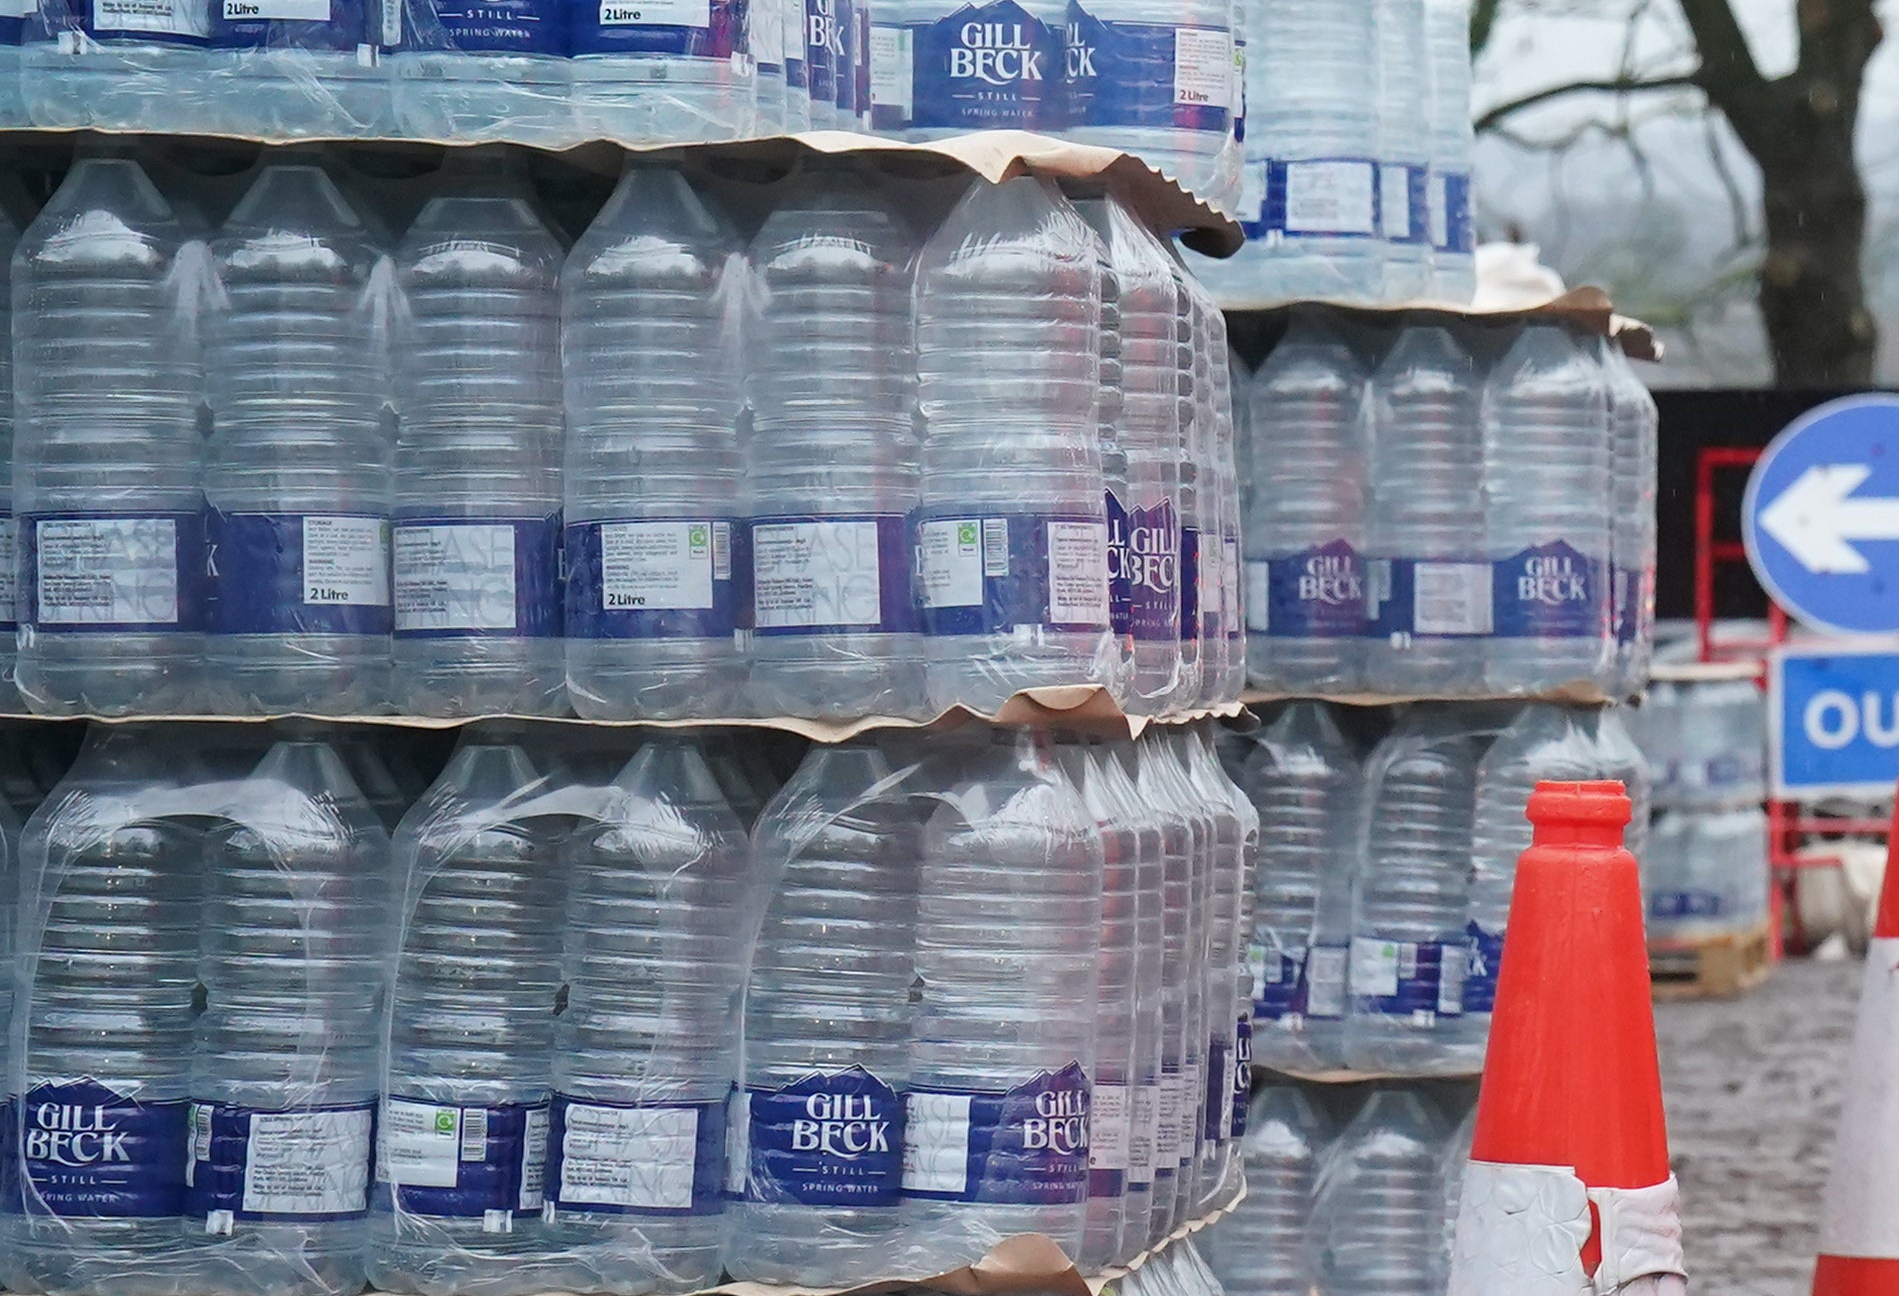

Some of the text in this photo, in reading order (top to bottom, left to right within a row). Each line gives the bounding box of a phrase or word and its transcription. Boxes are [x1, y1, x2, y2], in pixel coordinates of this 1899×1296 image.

[227, 3, 259, 15] 2 Litre
[467, 9, 513, 21] STILL
[605, 8, 641, 20] 2 Litre
[449, 28, 532, 39] SPRING WATER
[961, 22, 1031, 49] GILL
[950, 48, 1043, 85] BECK
[978, 92, 1017, 102] STILL
[1180, 90, 1186, 100] 2
[962, 108, 998, 117] SPRING
[1131, 555, 1174, 594] BEC
[1307, 555, 1352, 577] GILL
[1525, 556, 1573, 578] GILL
[310, 588, 349, 600] 2 Litre
[608, 593, 645, 605] 2 Litre
[1299, 575, 1361, 606] BECK
[1518, 575, 1586, 606] BECK
[806, 1093, 881, 1120] GILL
[1035, 1090, 1086, 1118] GILL
[37, 1102, 117, 1131] GILL
[792, 1119, 890, 1158] BECK
[1023, 1117, 1089, 1156] BECK
[26, 1128, 131, 1167] BECK
[822, 1166, 864, 1176] STILL
[51, 1175, 96, 1185] STILL
[802, 1183, 879, 1194] SPRING WATER
[77, 1193, 117, 1203] WATER
